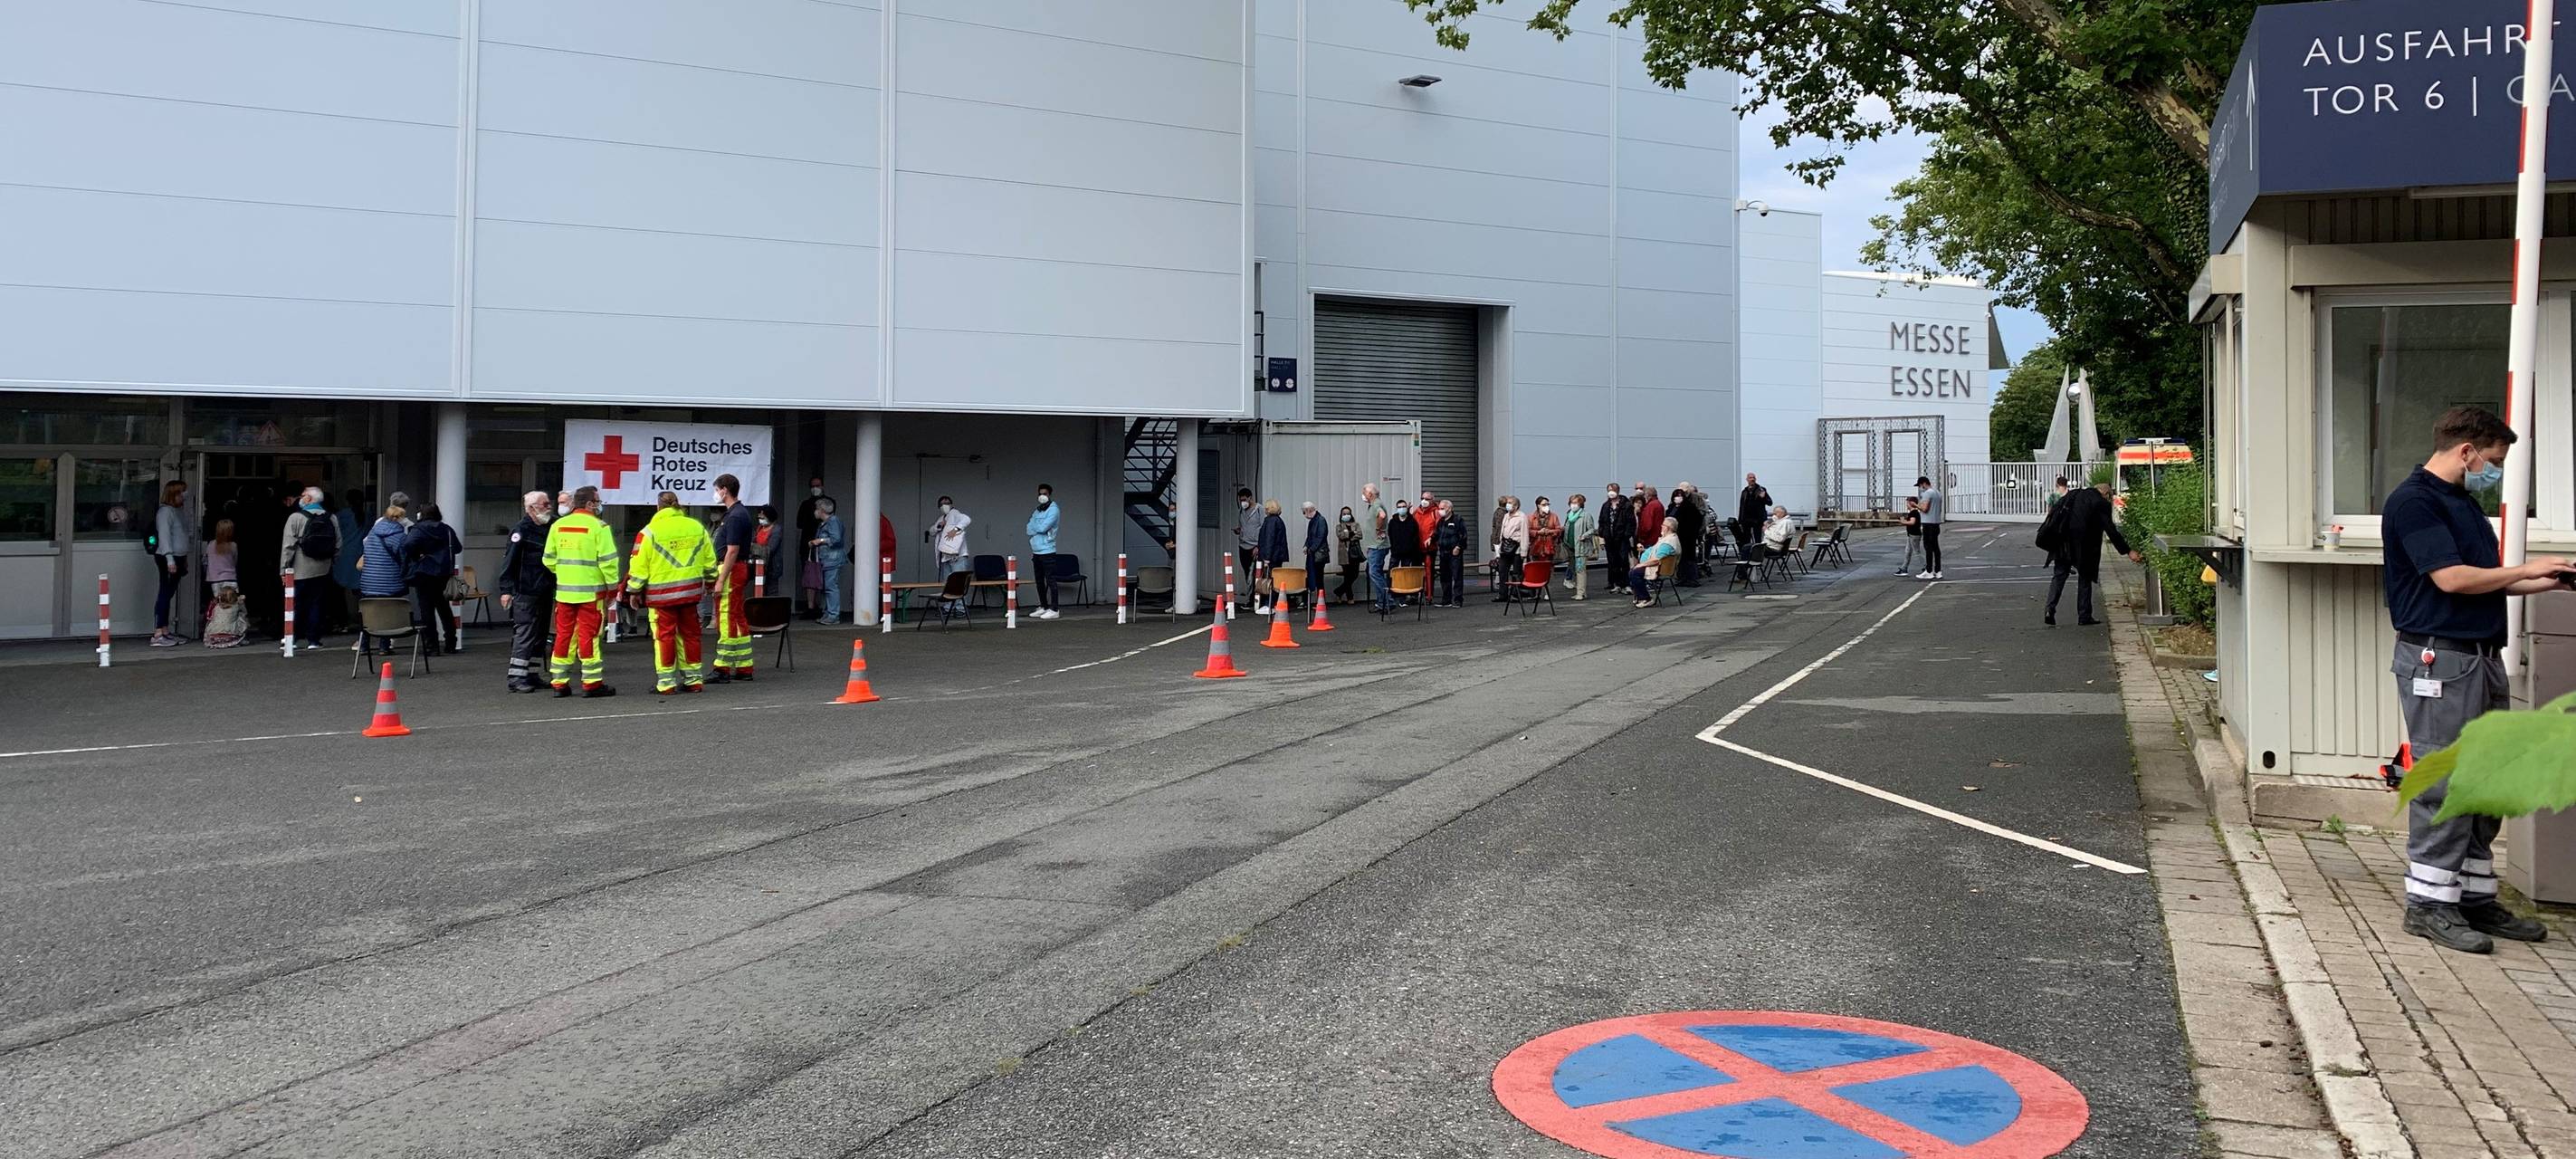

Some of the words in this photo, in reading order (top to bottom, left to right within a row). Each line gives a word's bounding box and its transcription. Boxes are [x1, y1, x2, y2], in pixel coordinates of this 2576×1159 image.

[2303, 21, 2562, 67] AUSFAHR
[2303, 83, 2399, 116] TOR
[2424, 81, 2445, 110] 6
[1890, 321, 1970, 355] MESSE
[1890, 366, 1970, 398] ESSEN
[653, 436, 752, 455] Deutsches
[652, 455, 708, 472] Rotes
[651, 474, 706, 491] Kreuz
